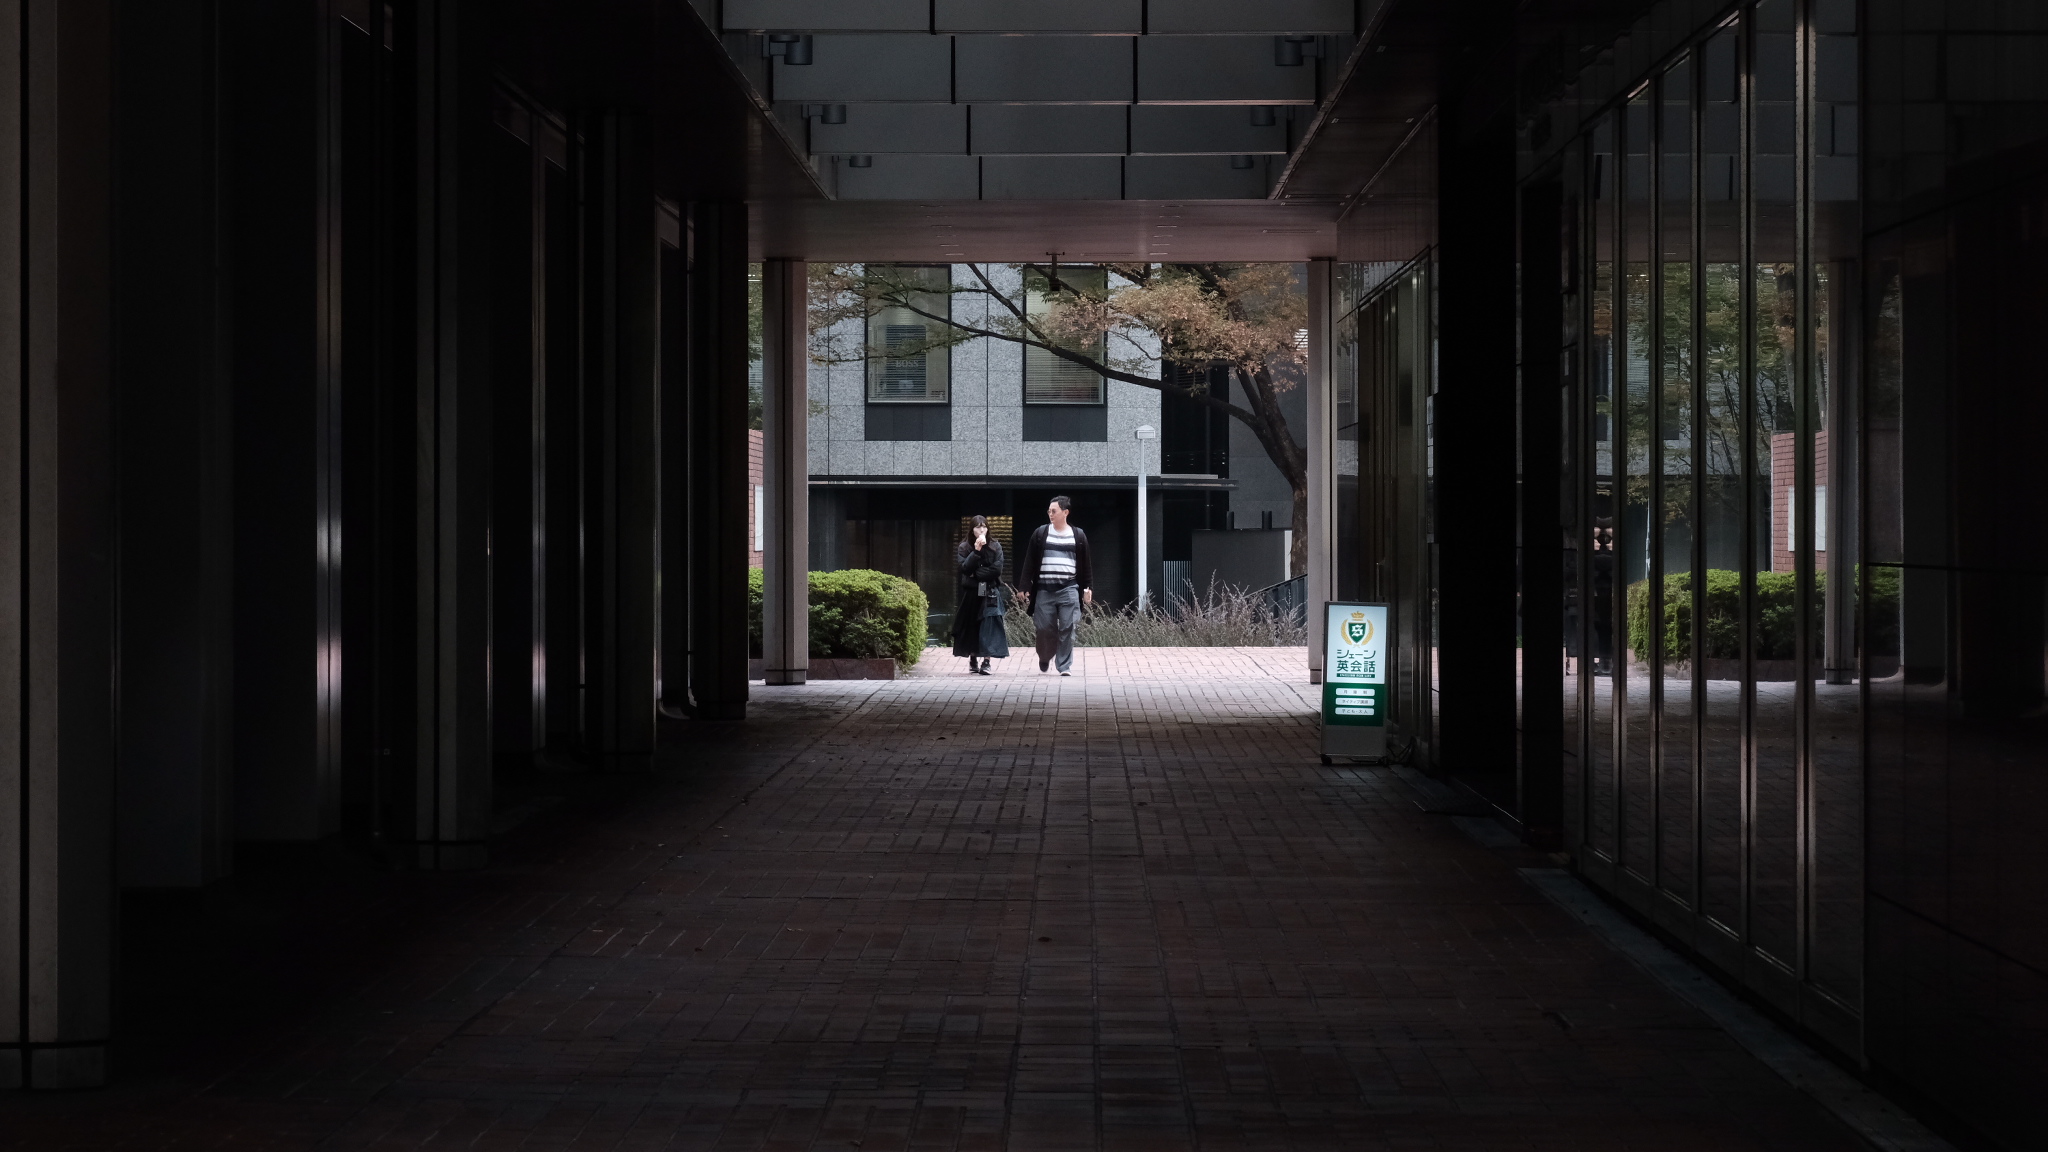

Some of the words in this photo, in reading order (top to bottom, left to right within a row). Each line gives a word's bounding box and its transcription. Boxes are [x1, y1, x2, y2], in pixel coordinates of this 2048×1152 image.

[1351, 624, 1364, 637] S
[1337, 649, 1376, 659] シェーン
[1337, 660, 1376, 672] 英会話
